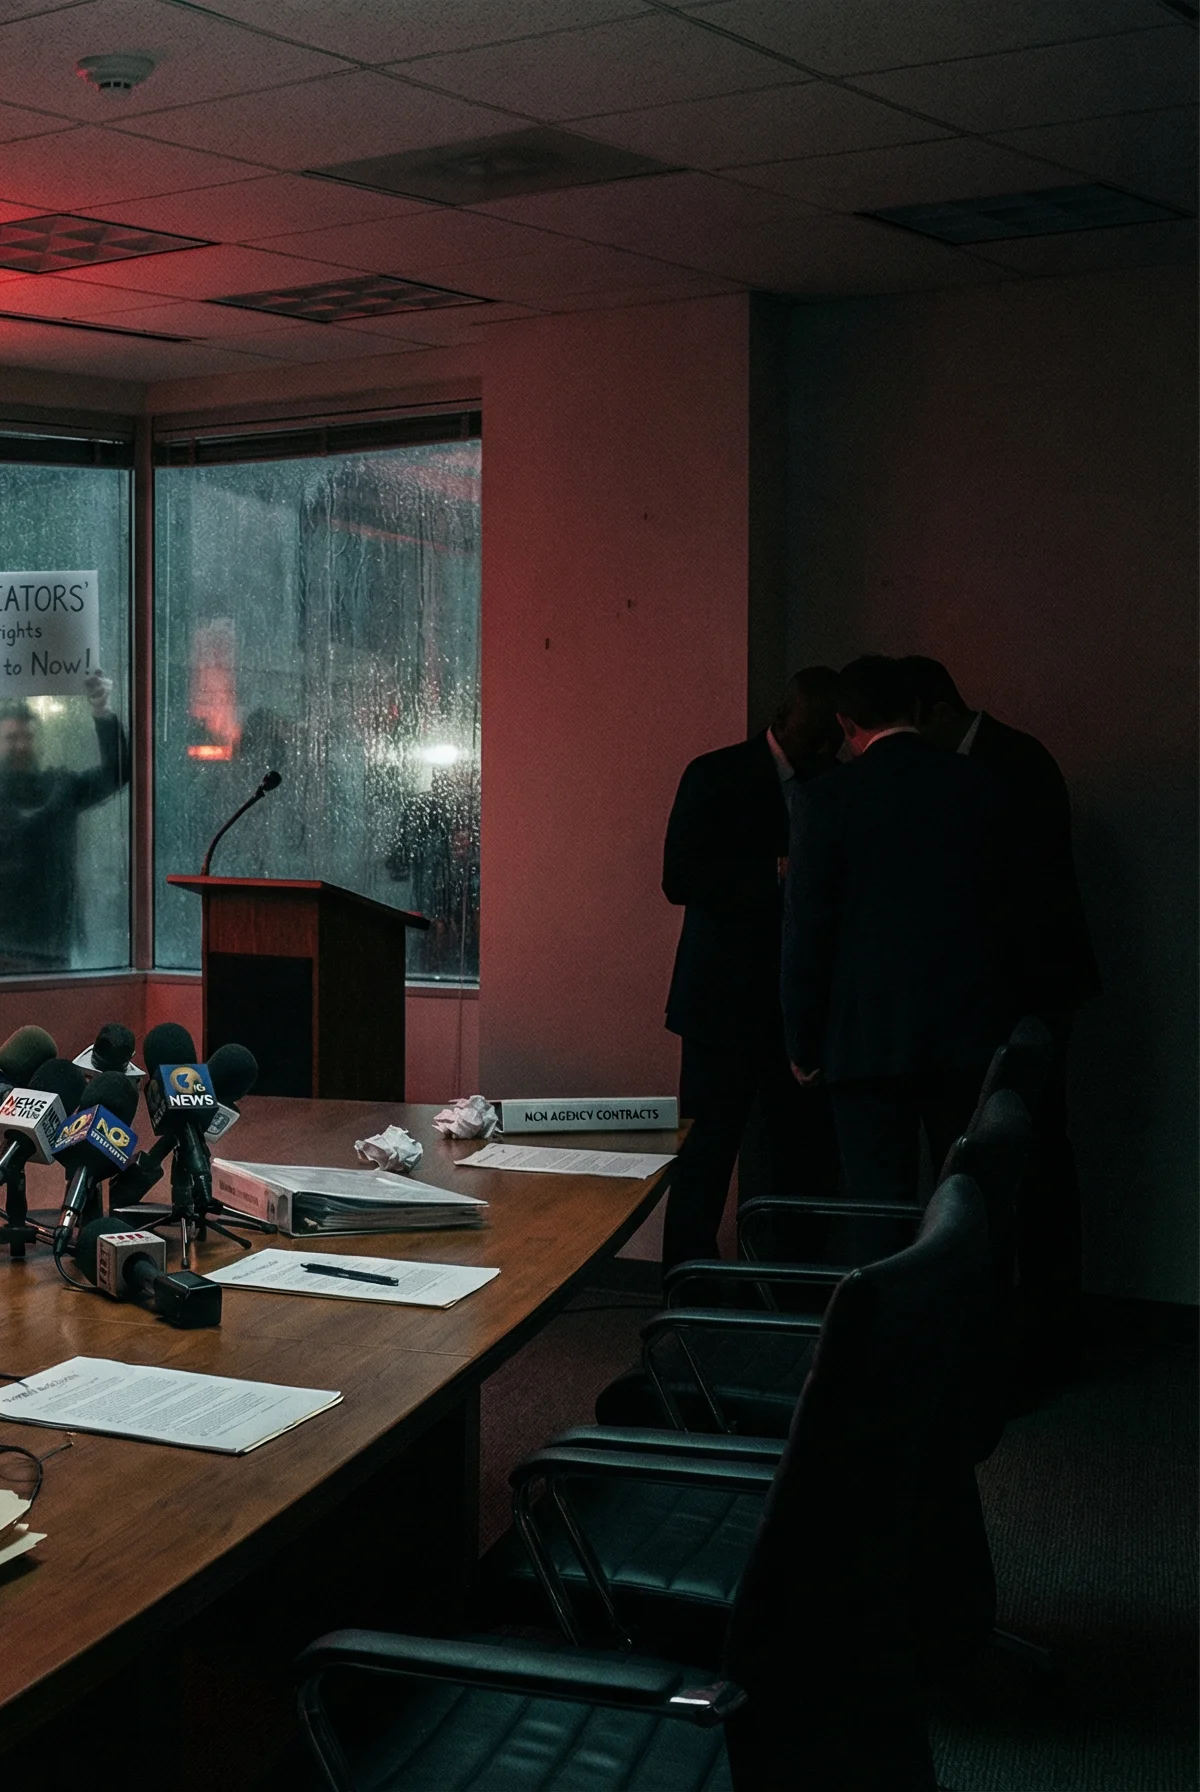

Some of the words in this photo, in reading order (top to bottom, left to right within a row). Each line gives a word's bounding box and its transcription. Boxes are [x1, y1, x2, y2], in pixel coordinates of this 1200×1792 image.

[3, 658, 22, 676] to
[31, 648, 90, 676] Now!
[169, 1094, 214, 1107] NEWS
[597, 1109, 659, 1120] CONTRACTS
